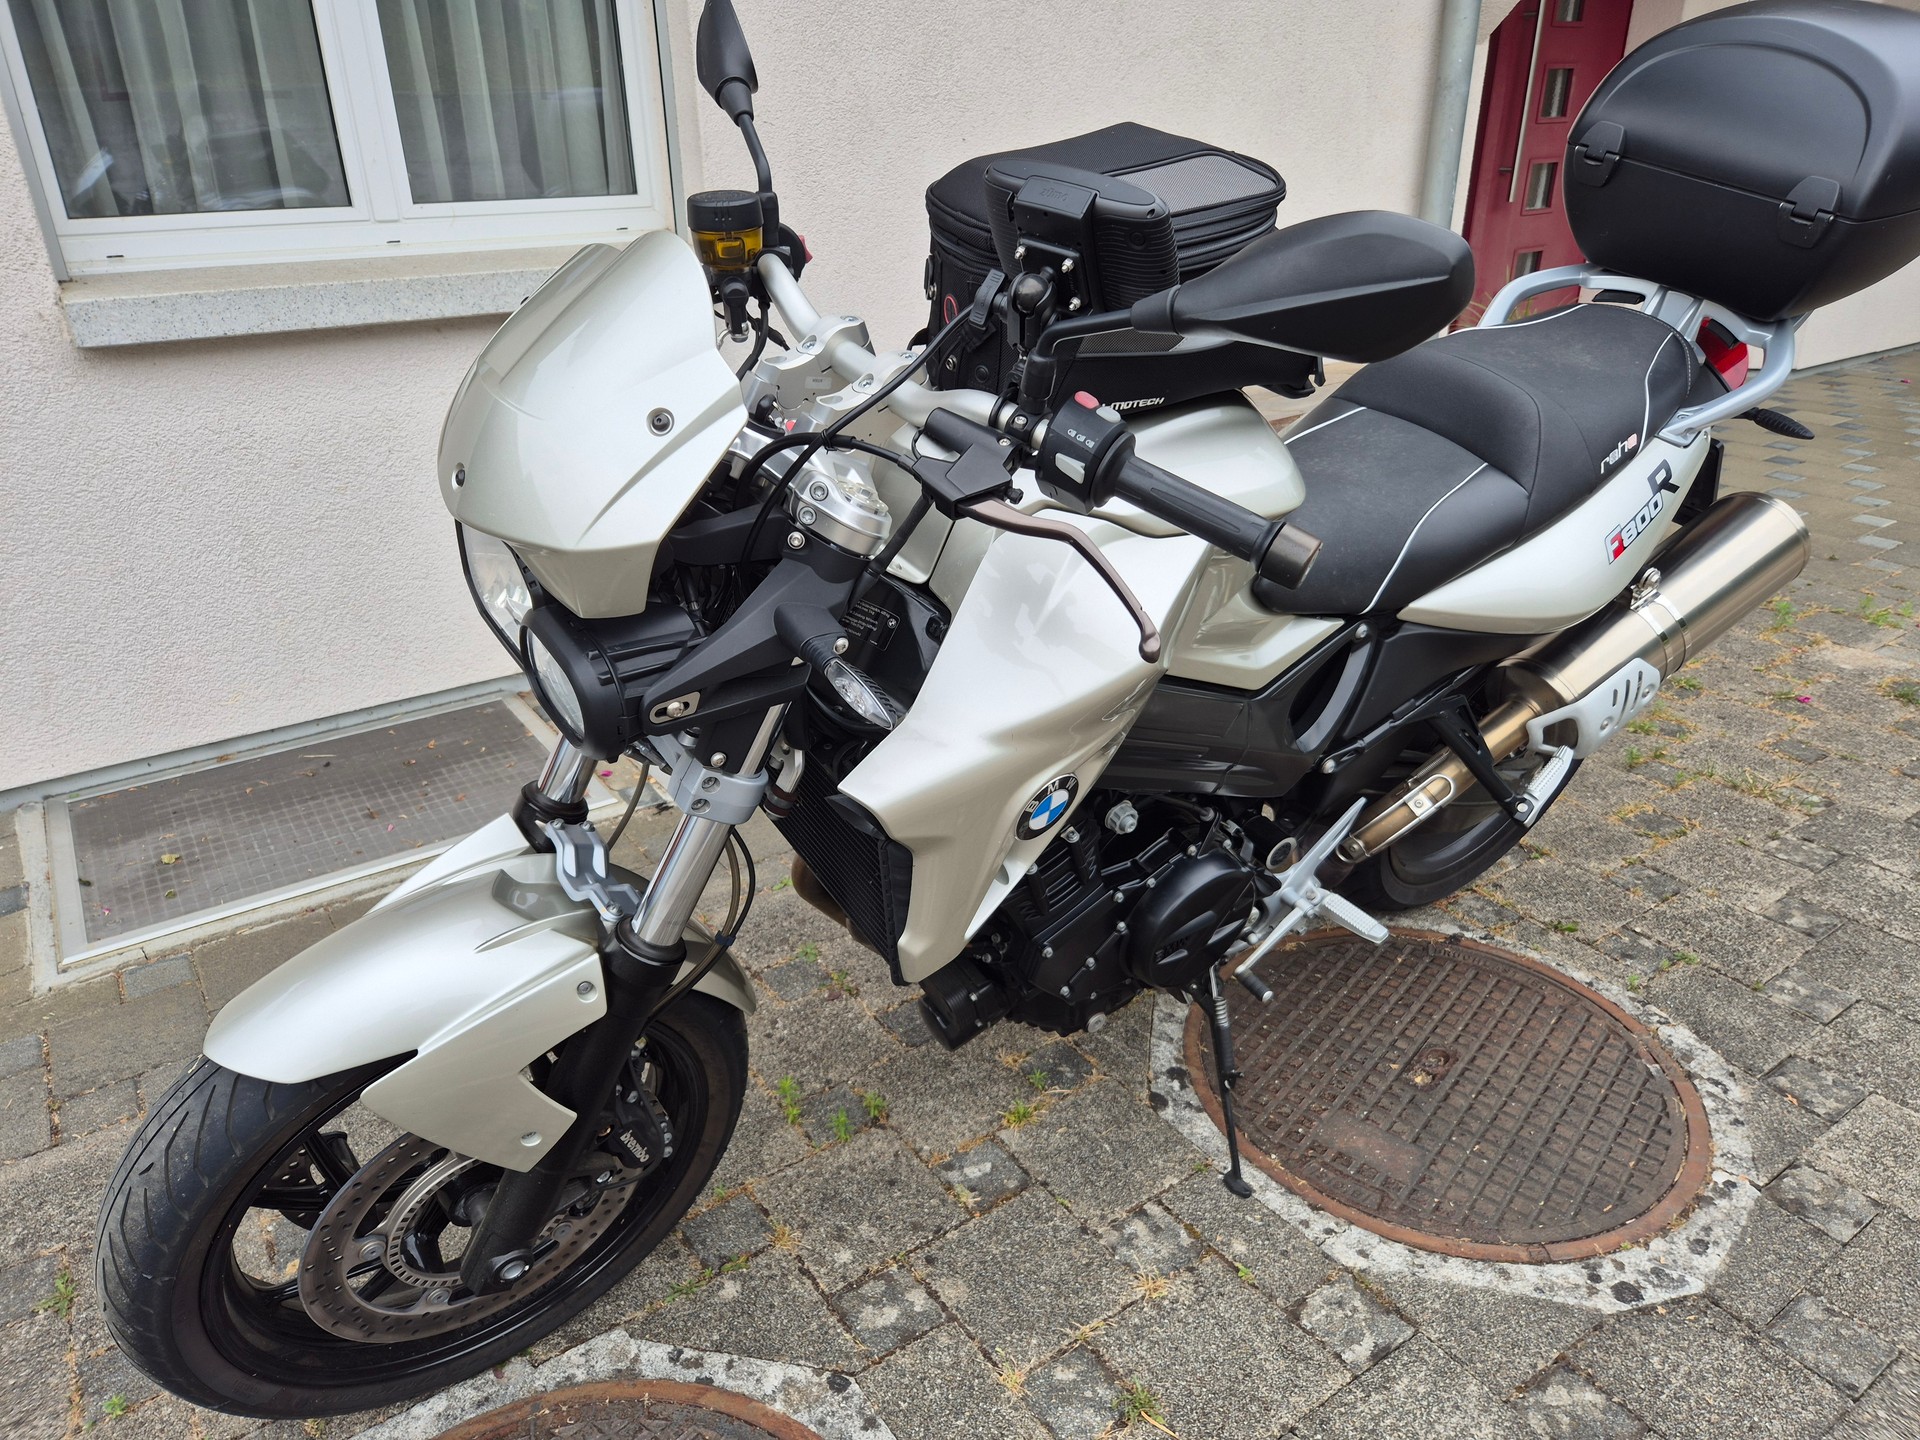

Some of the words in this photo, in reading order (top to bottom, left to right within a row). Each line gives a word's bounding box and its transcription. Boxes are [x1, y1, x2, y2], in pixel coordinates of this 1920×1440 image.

[1102, 397, 1165, 411] MOTECH
[1024, 776, 1078, 813] BMW
[620, 1129, 650, 1163] brembo
